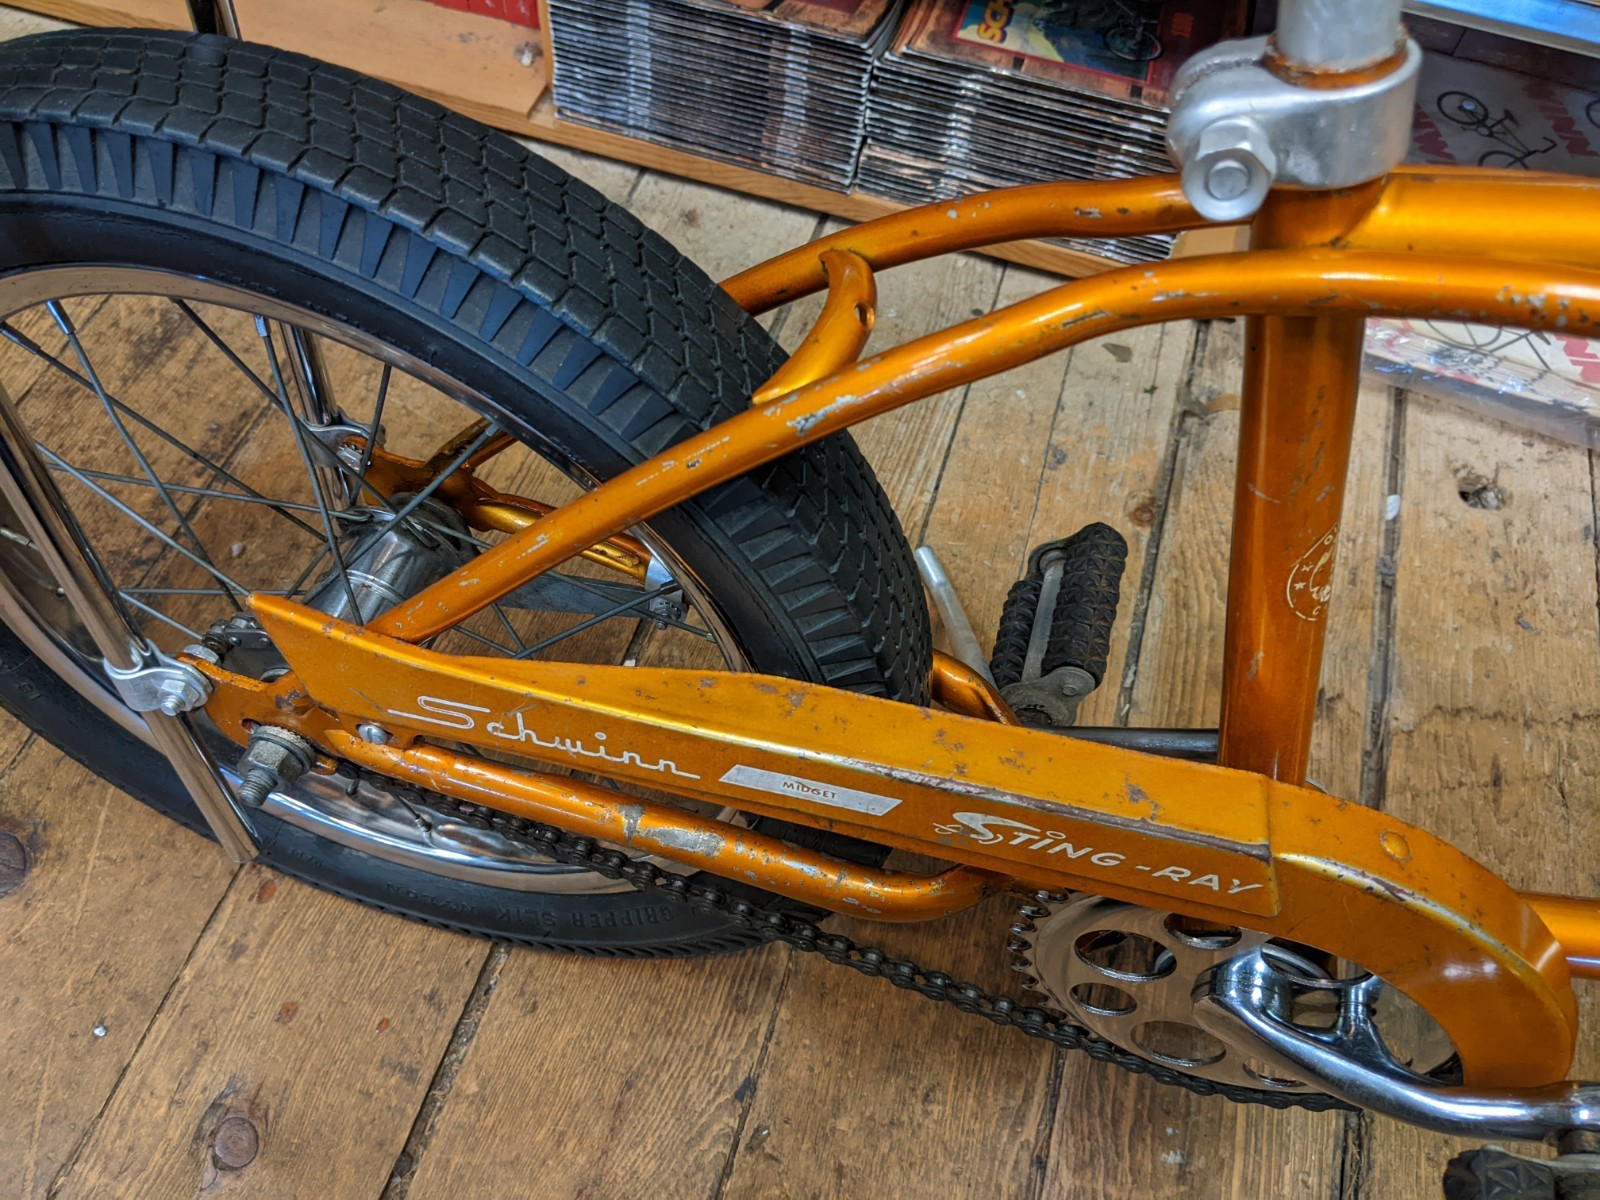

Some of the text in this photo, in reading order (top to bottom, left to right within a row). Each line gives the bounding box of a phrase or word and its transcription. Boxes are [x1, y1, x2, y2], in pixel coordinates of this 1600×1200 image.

[387, 695, 701, 780] Schwinn
[782, 781, 838, 800] MIDGET
[497, 905, 557, 927] SLIK
[572, 904, 675, 929] GRIPPER
